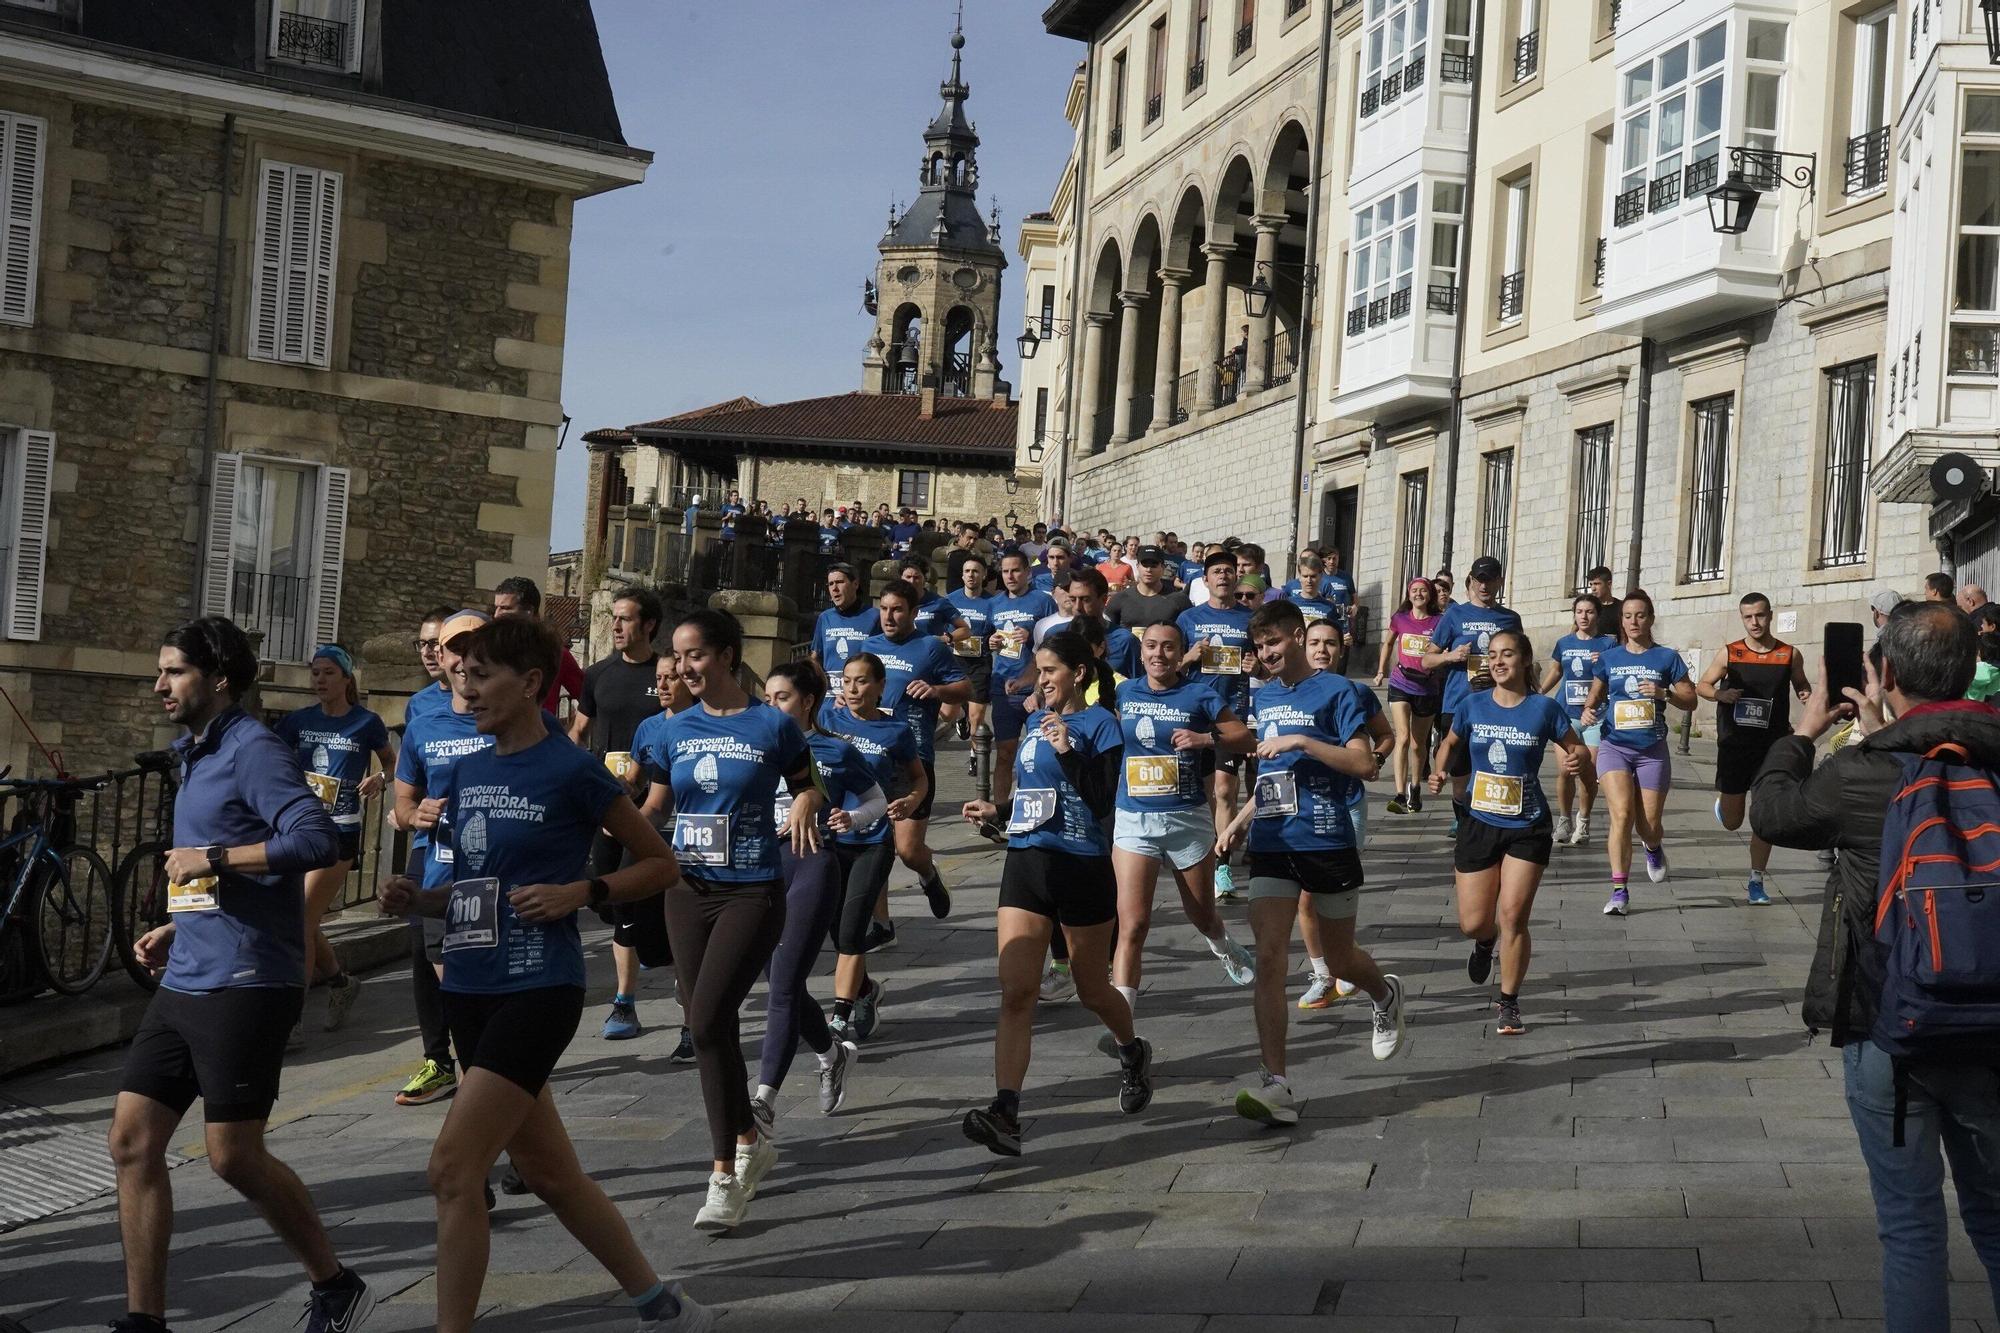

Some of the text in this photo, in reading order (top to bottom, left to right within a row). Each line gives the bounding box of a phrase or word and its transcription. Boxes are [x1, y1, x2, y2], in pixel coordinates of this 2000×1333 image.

[1574, 686, 1589, 696] 744
[1128, 701, 1167, 709] CONQUISTA
[1261, 705, 1292, 715] CONQUISTA
[1128, 706, 1180, 716] ALMENDRA
[1259, 710, 1304, 722] ALMENDRA
[1745, 705, 1763, 717] 756
[1153, 715, 1191, 723] KONKISTA
[1478, 724, 1518, 732] CONQUISTA
[304, 730, 340, 738] CONQUISTA
[1478, 730, 1531, 740] ALMENDRA
[304, 735, 352, 745] ALMENDRA
[425, 737, 485, 749] LA CONQUISTA
[686, 736, 735, 746] CONQUISTA
[1505, 739, 1539, 747] KONKISTA
[328, 743, 360, 753] KONKISTA
[687, 743, 752, 754] ALMENDRA
[718, 751, 764, 763] KONKISTA
[1139, 765, 1164, 781] 610
[461, 785, 510, 797] CONQUISTA
[1261, 783, 1281, 801] 958
[1485, 783, 1509, 800] 537
[459, 795, 546, 813] ALMENDRA REN
[1023, 800, 1043, 818] 913
[488, 809, 544, 823] KONKISTA
[682, 827, 713, 847] 1013
